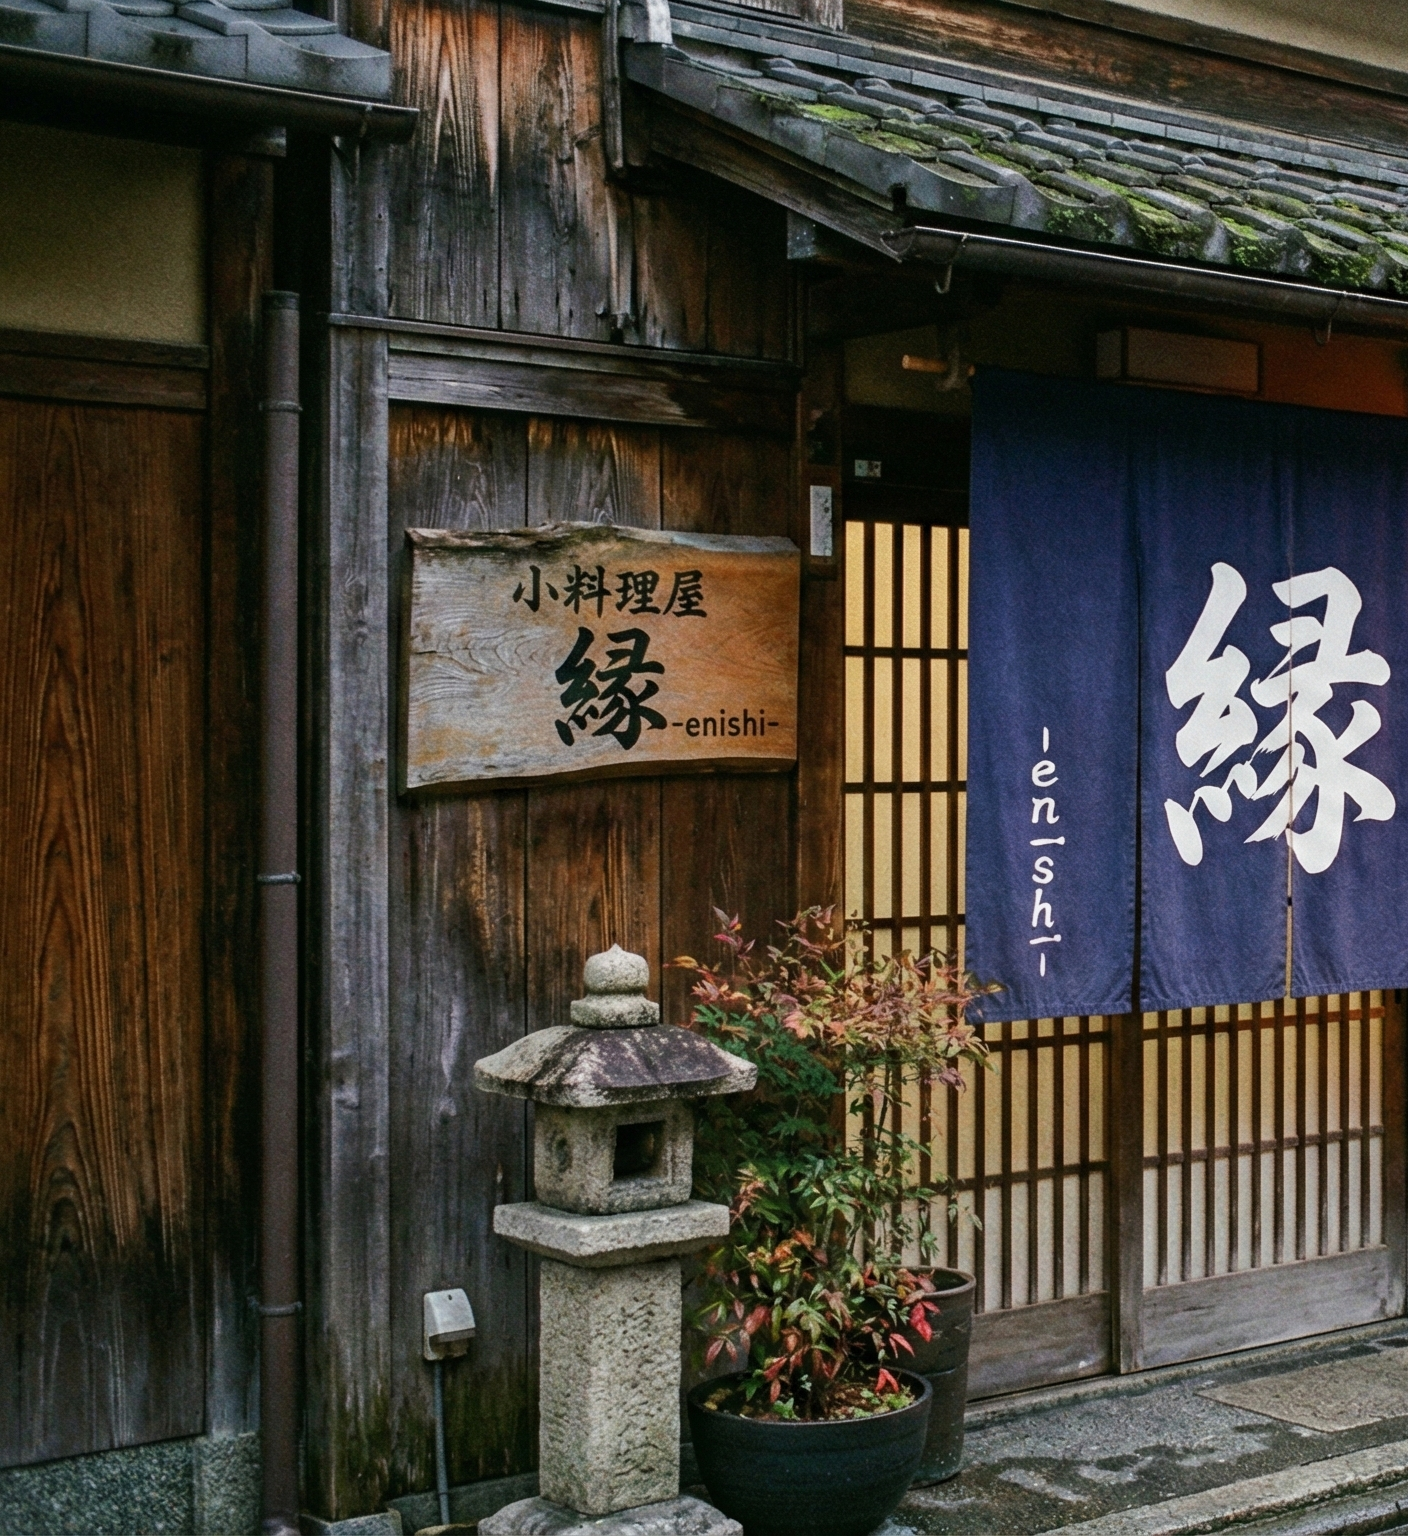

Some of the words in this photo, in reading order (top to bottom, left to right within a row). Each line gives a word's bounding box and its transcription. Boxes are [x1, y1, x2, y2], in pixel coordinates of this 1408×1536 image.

[512, 564, 708, 619] 小料理屋
[554, 626, 667, 751] 縁
[672, 708, 780, 738] -enishi-
[1165, 562, 1396, 875] 縁
